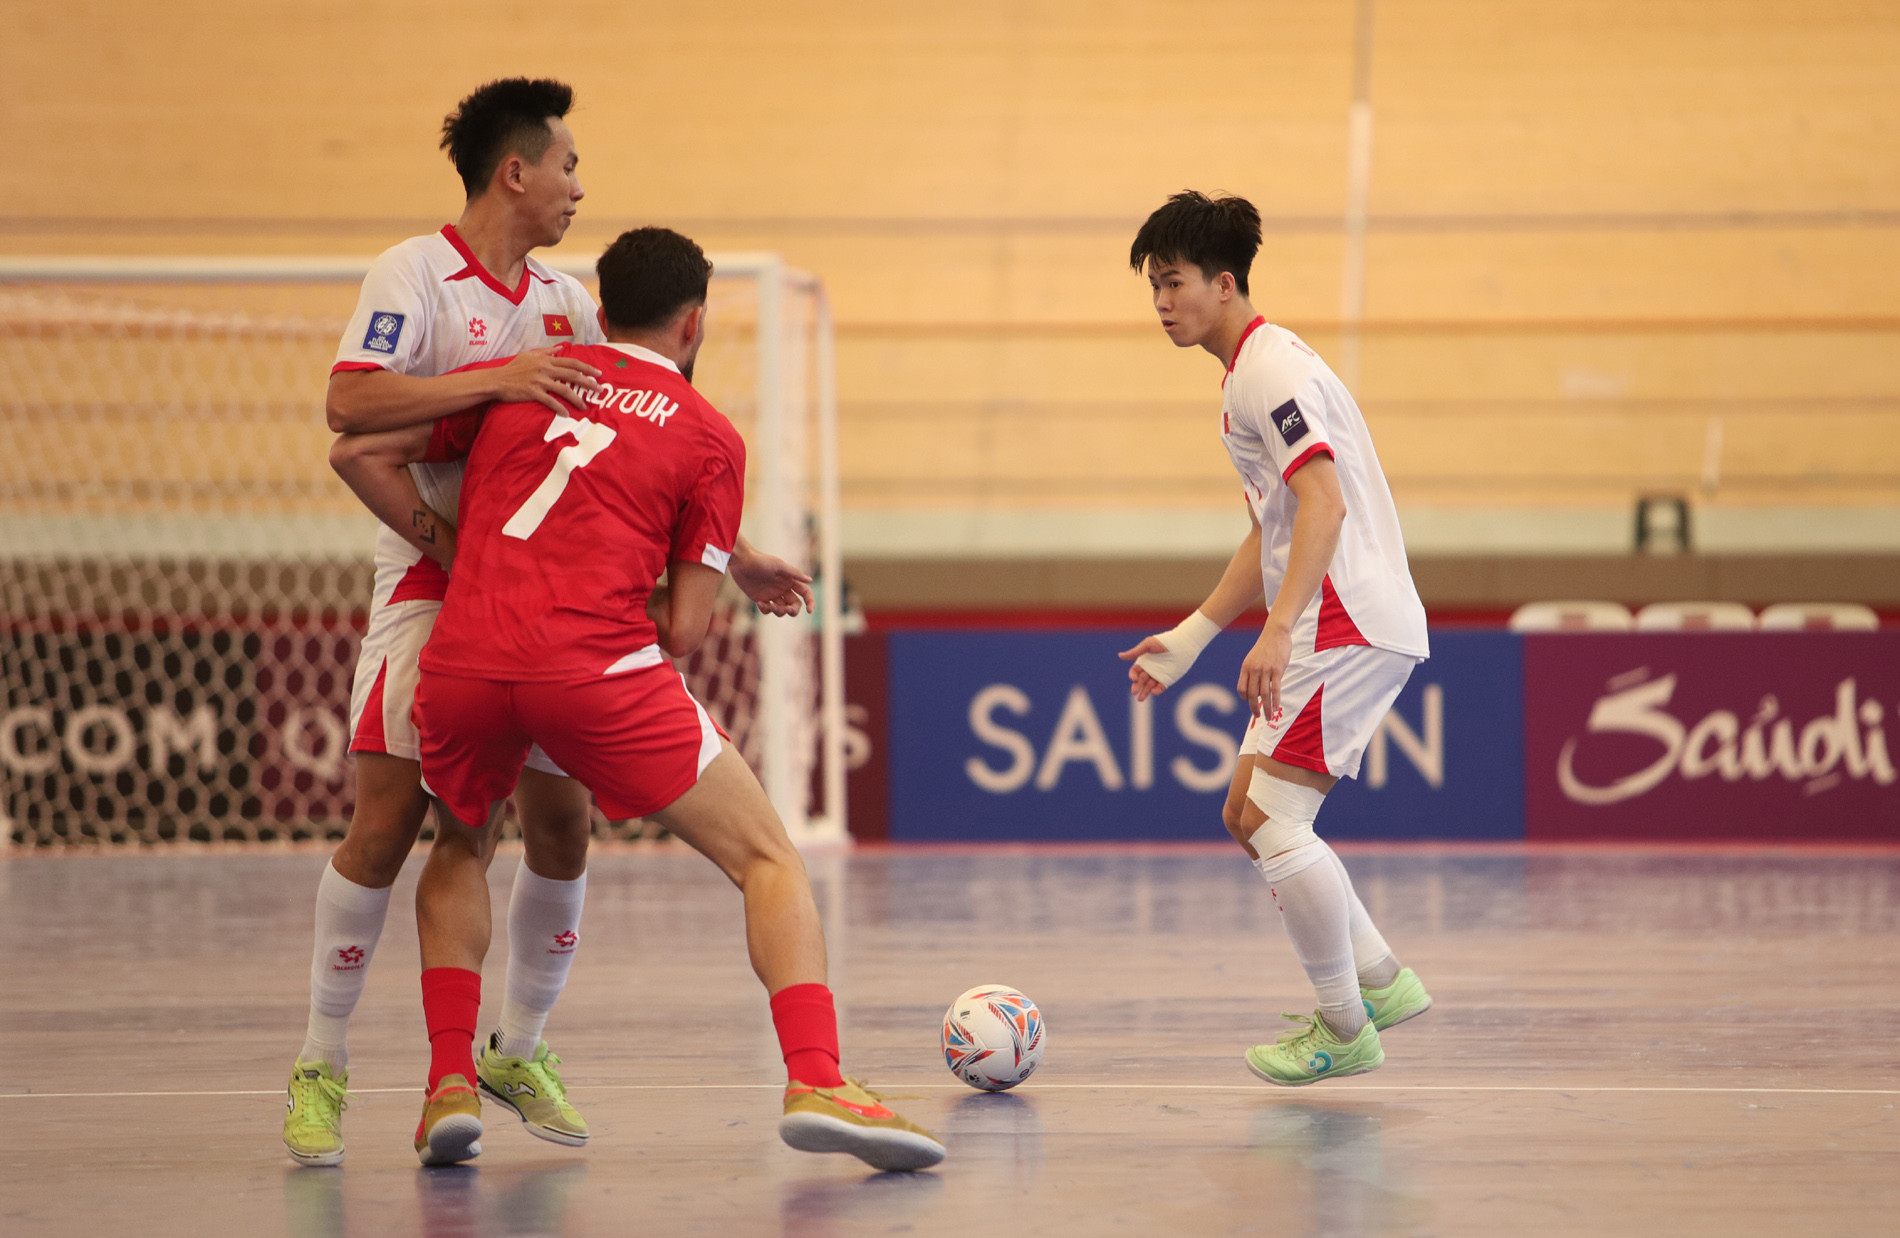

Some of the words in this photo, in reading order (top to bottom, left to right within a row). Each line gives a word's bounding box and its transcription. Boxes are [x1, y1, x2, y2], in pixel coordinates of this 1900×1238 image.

[1281, 410, 1301, 432] AFC
[501, 413, 618, 541] 7
[0, 703, 218, 774] COM
[965, 684, 1445, 793] SAISN
[1557, 667, 1896, 805] Saudi
